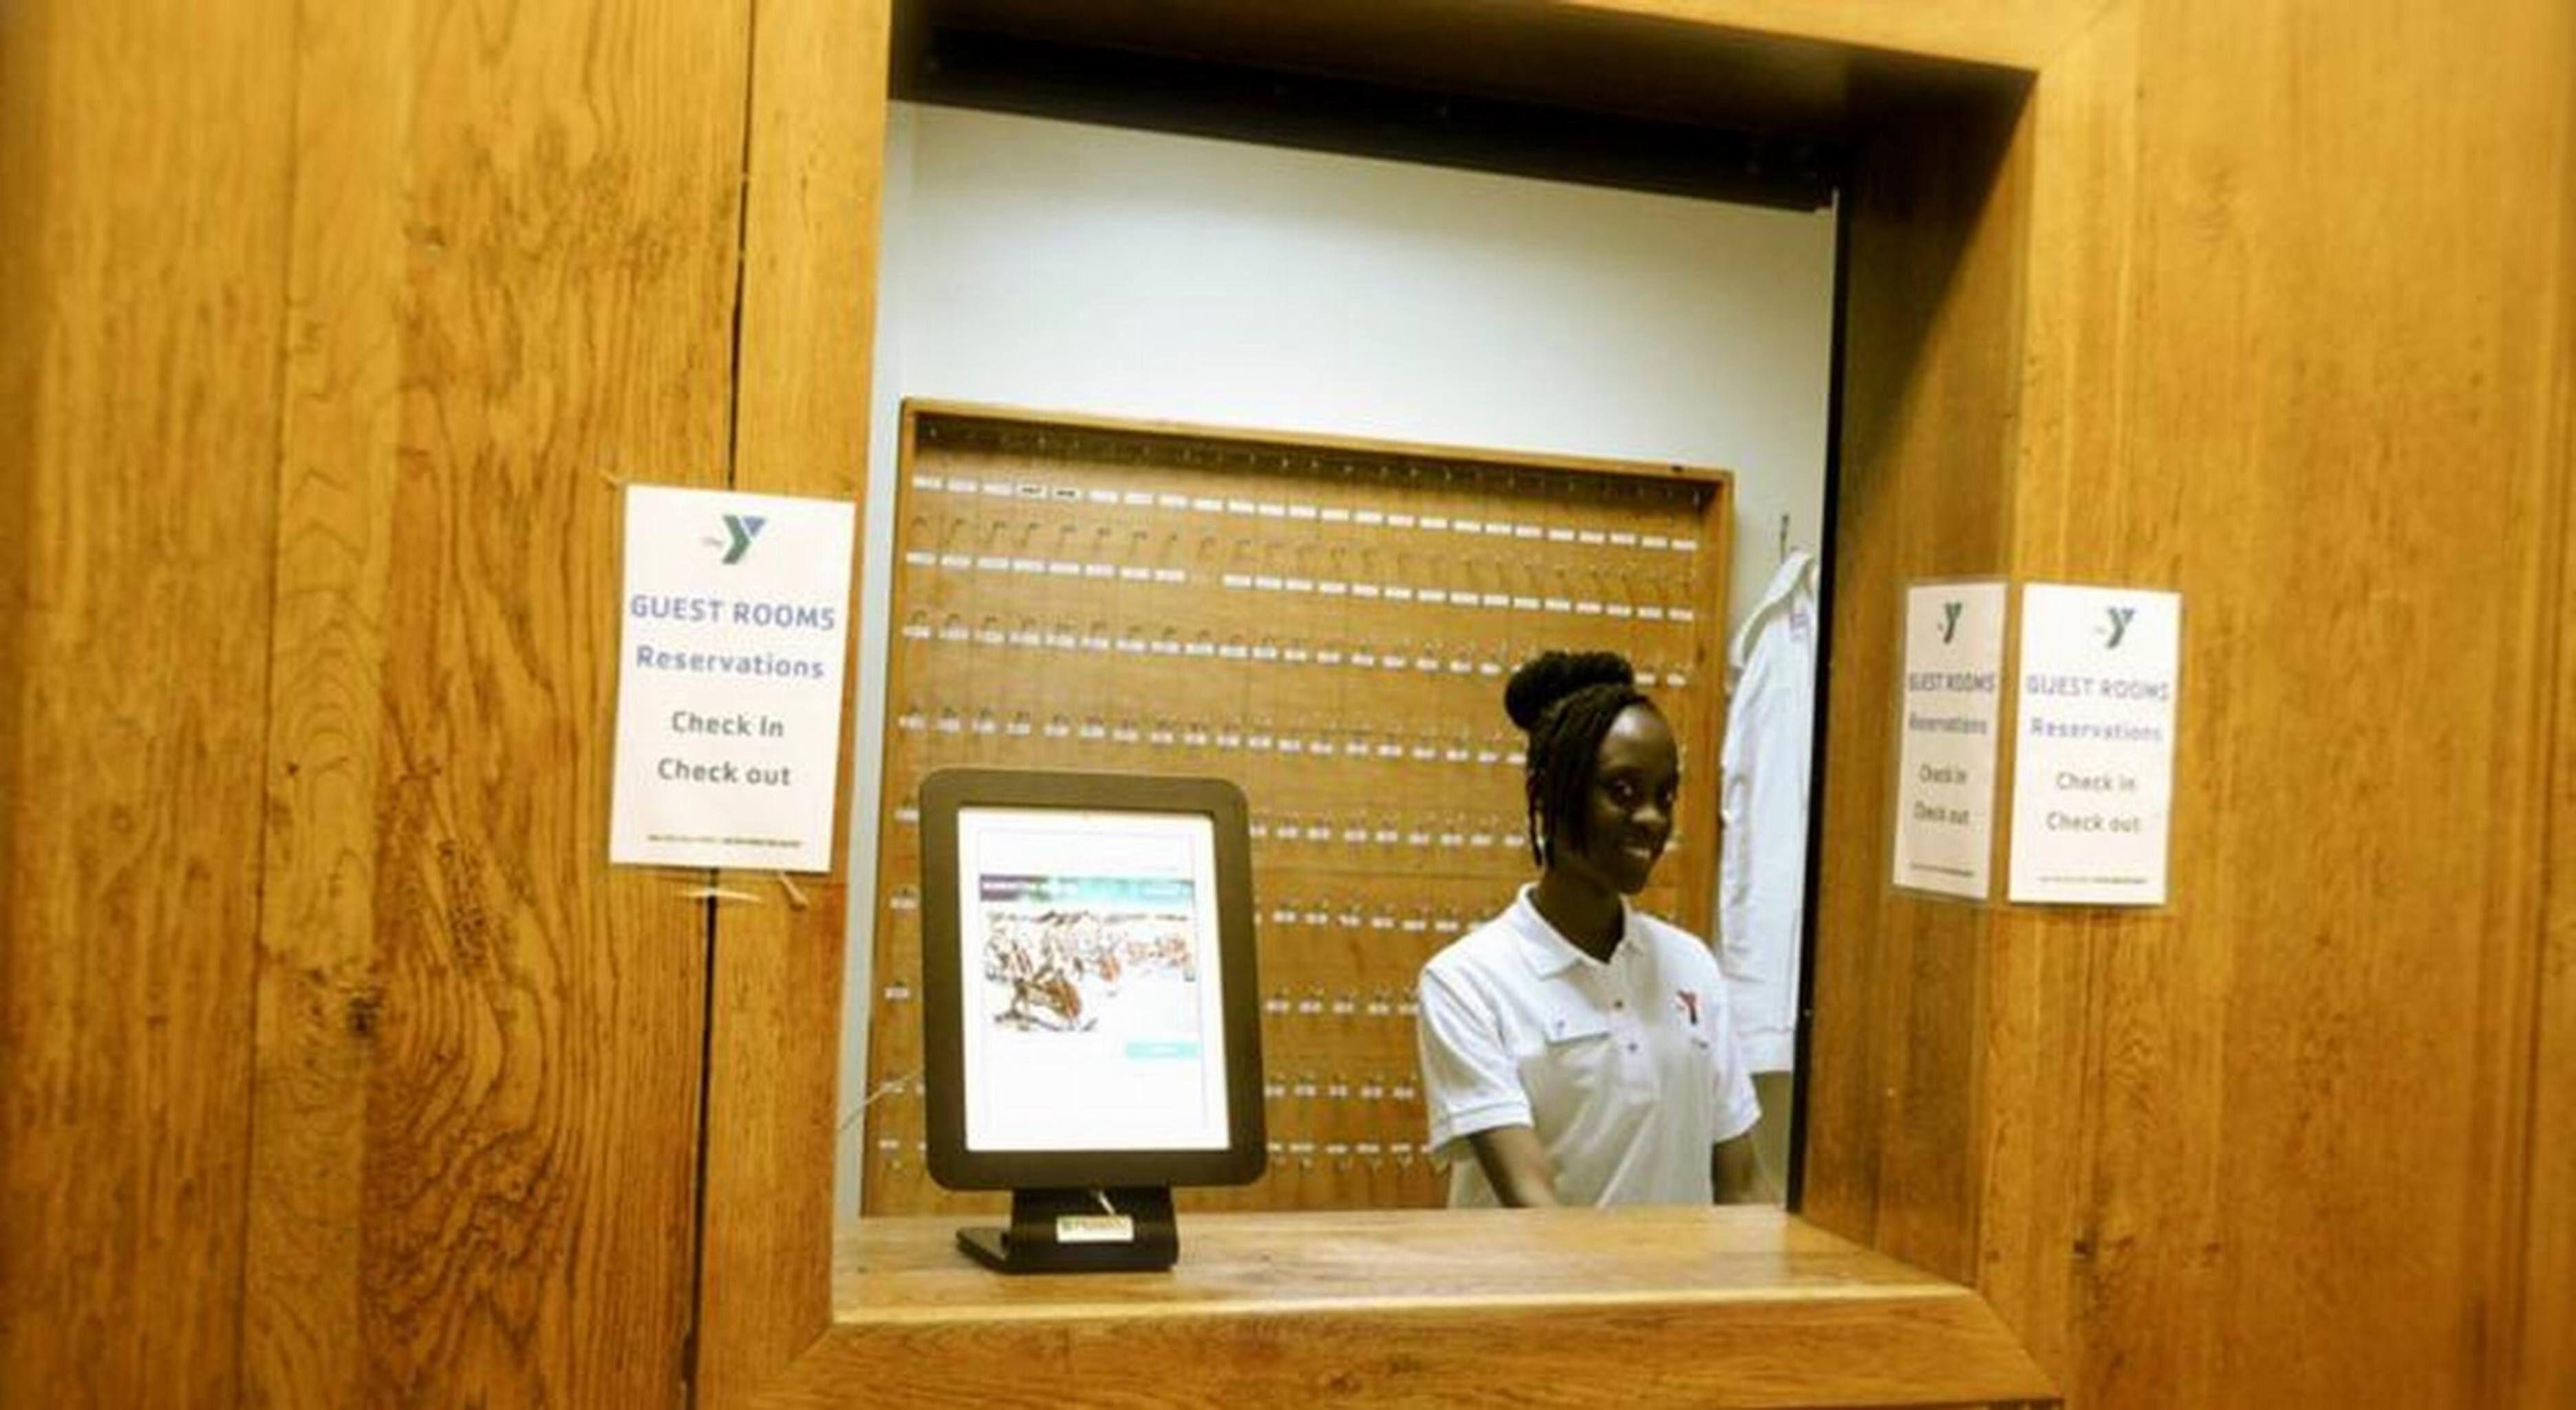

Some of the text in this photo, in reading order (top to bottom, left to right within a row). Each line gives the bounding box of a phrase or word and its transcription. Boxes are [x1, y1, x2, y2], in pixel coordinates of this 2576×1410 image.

[631, 594, 835, 631] GUEST ROOMS
[636, 644, 825, 679] Reservations
[2027, 674, 2169, 702] GUEST ROOMS
[672, 711, 752, 736] Check
[2032, 717, 2163, 741] Reservations
[658, 757, 791, 786] Check out
[2056, 772, 2112, 792] Check
[2046, 810, 2140, 834] Check out
